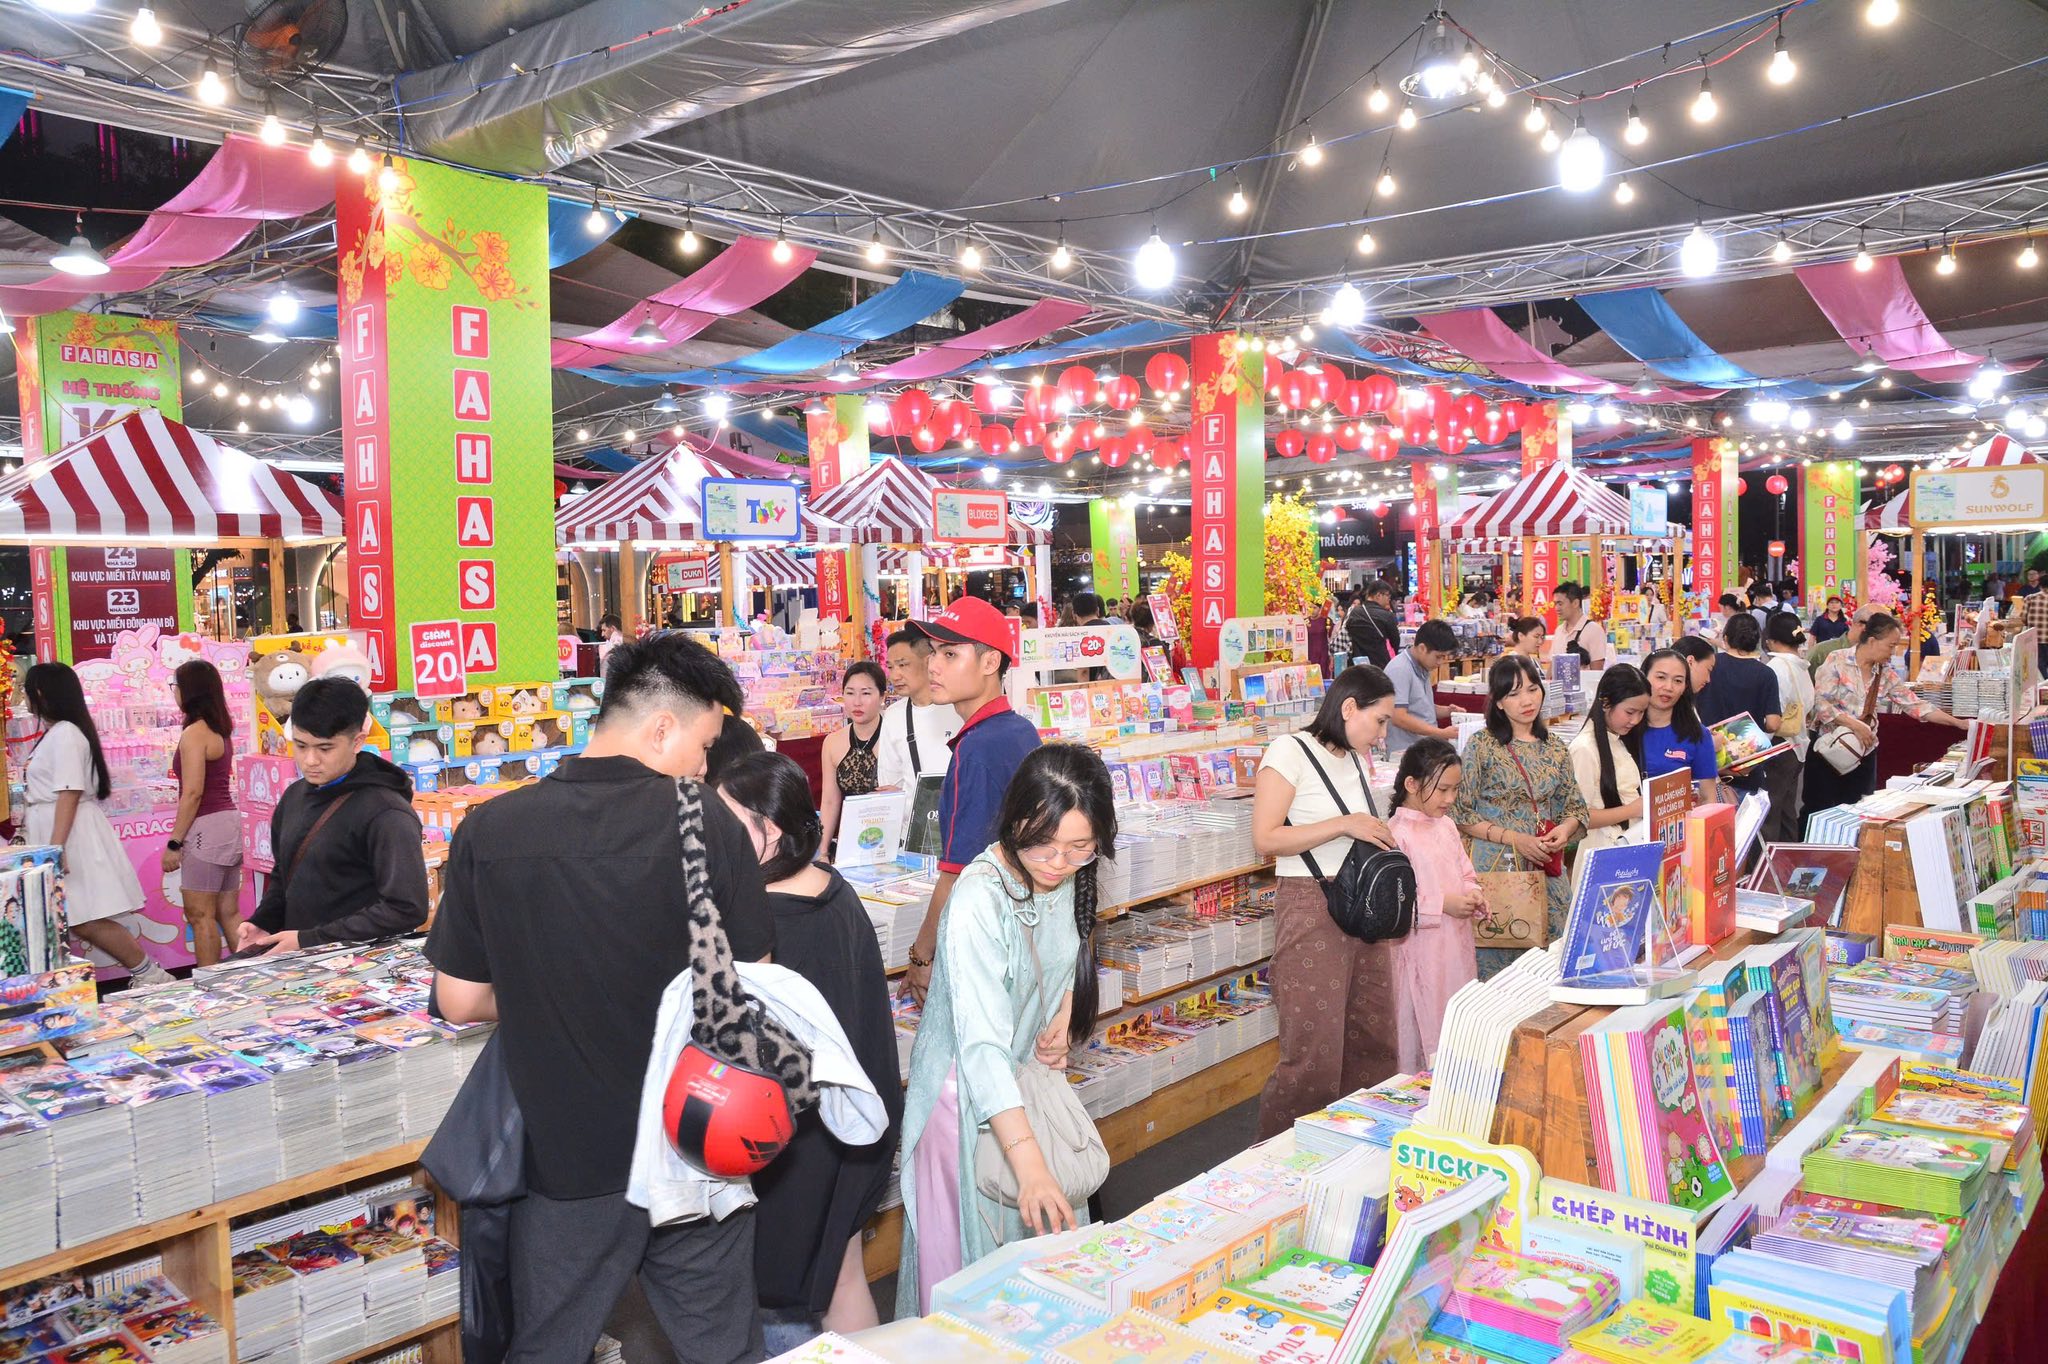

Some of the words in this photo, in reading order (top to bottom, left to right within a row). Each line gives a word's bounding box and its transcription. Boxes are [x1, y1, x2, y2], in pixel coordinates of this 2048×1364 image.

[63, 346, 158, 369] FAHASA
[63, 378, 90, 399] HỆ
[356, 312, 383, 677] FAHASA
[458, 311, 495, 668] FAHASA
[968, 509, 998, 520] BLOKEES
[1965, 504, 2034, 515] SUNWOLF
[1205, 418, 1222, 625] FAHASA
[1320, 533, 1335, 547] TRẢ
[1338, 532, 1354, 547] GÓP
[1356, 534, 1370, 546] 0%
[1701, 483, 1713, 596] FAHASA
[1825, 496, 1836, 588] FAHASA
[107, 546, 135, 560] 24
[71, 571, 87, 582] KHU
[89, 571, 105, 583] VỰC
[106, 569, 125, 582] MIỀN
[126, 569, 142, 581] TÂY
[142, 571, 159, 581] NAM
[161, 570, 171, 583] BỘ
[111, 591, 136, 606] 23
[73, 619, 88, 630] KHU
[90, 619, 105, 631] VỰC
[106, 617, 125, 630] MIỀN
[164, 617, 175, 630] BỘ
[94, 632, 107, 644] VÀ
[107, 632, 119, 644] TÂ
[419, 640, 454, 648] discount
[1551, 1196, 1616, 1226] GHÉP
[1623, 1214, 1689, 1250] HÌNH
